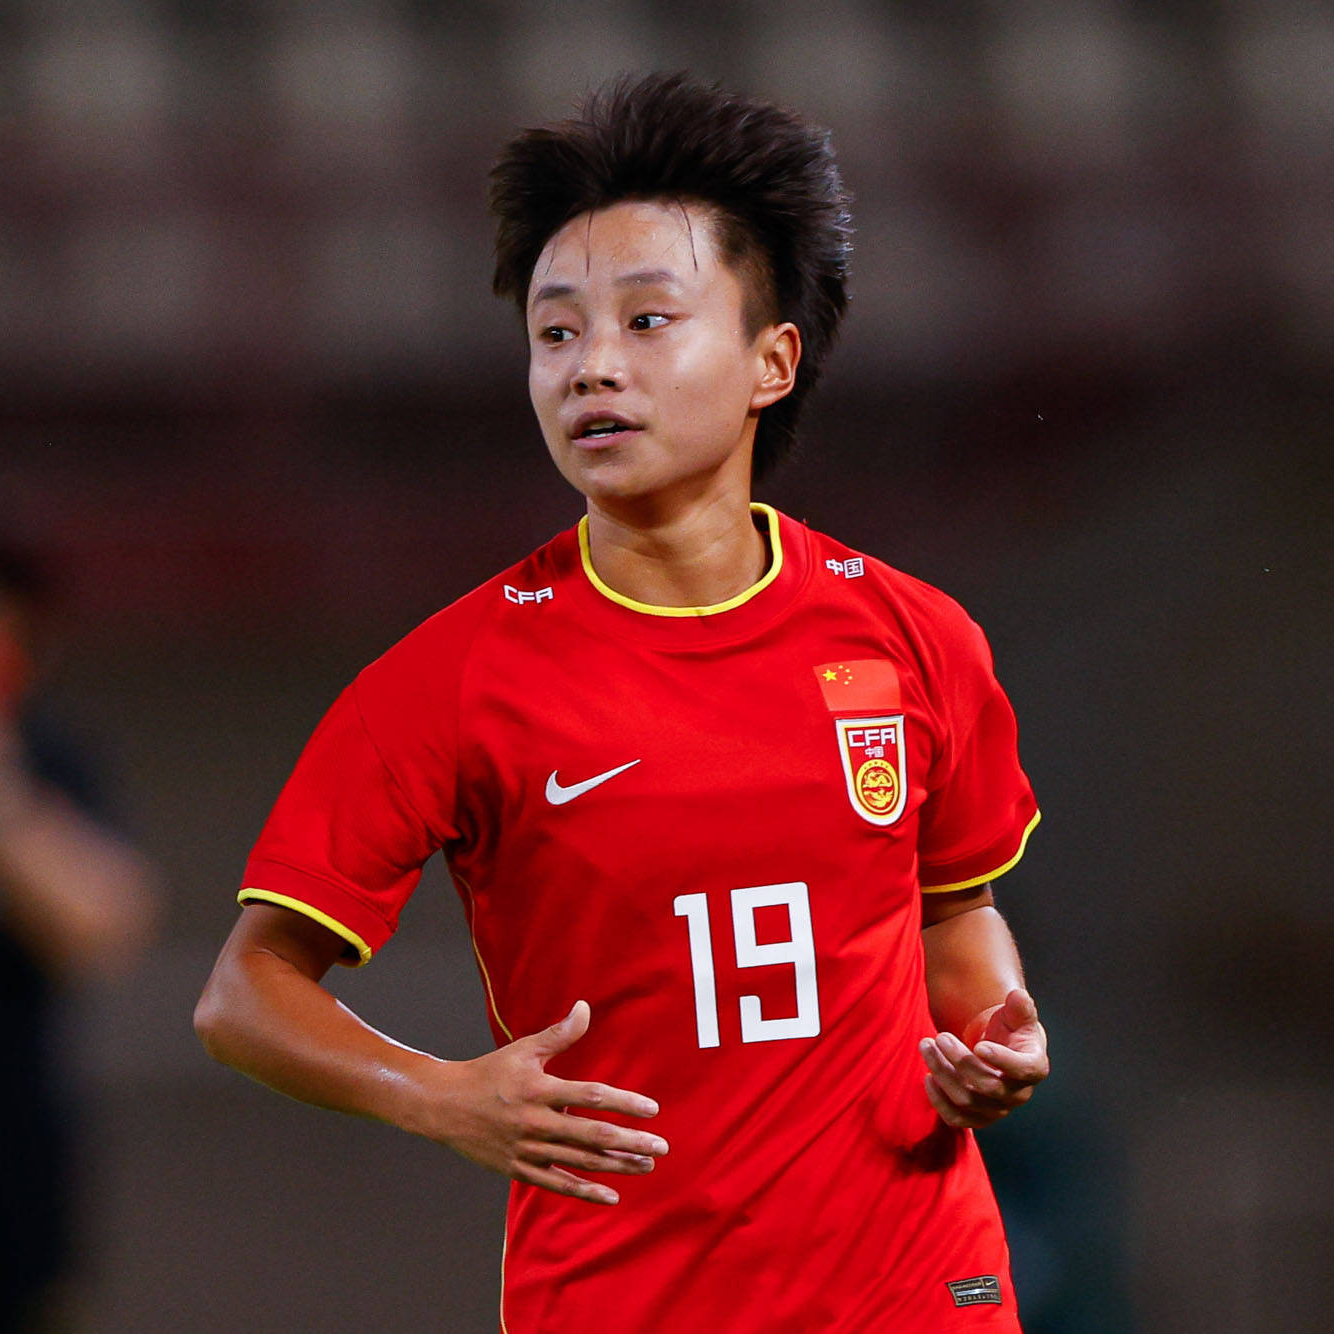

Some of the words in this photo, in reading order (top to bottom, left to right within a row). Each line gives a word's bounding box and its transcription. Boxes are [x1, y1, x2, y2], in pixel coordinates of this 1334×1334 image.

[825, 557, 865, 579] 中国
[503, 584, 554, 605] CFA
[847, 727, 896, 748] CFA
[673, 881, 821, 1049] 19
